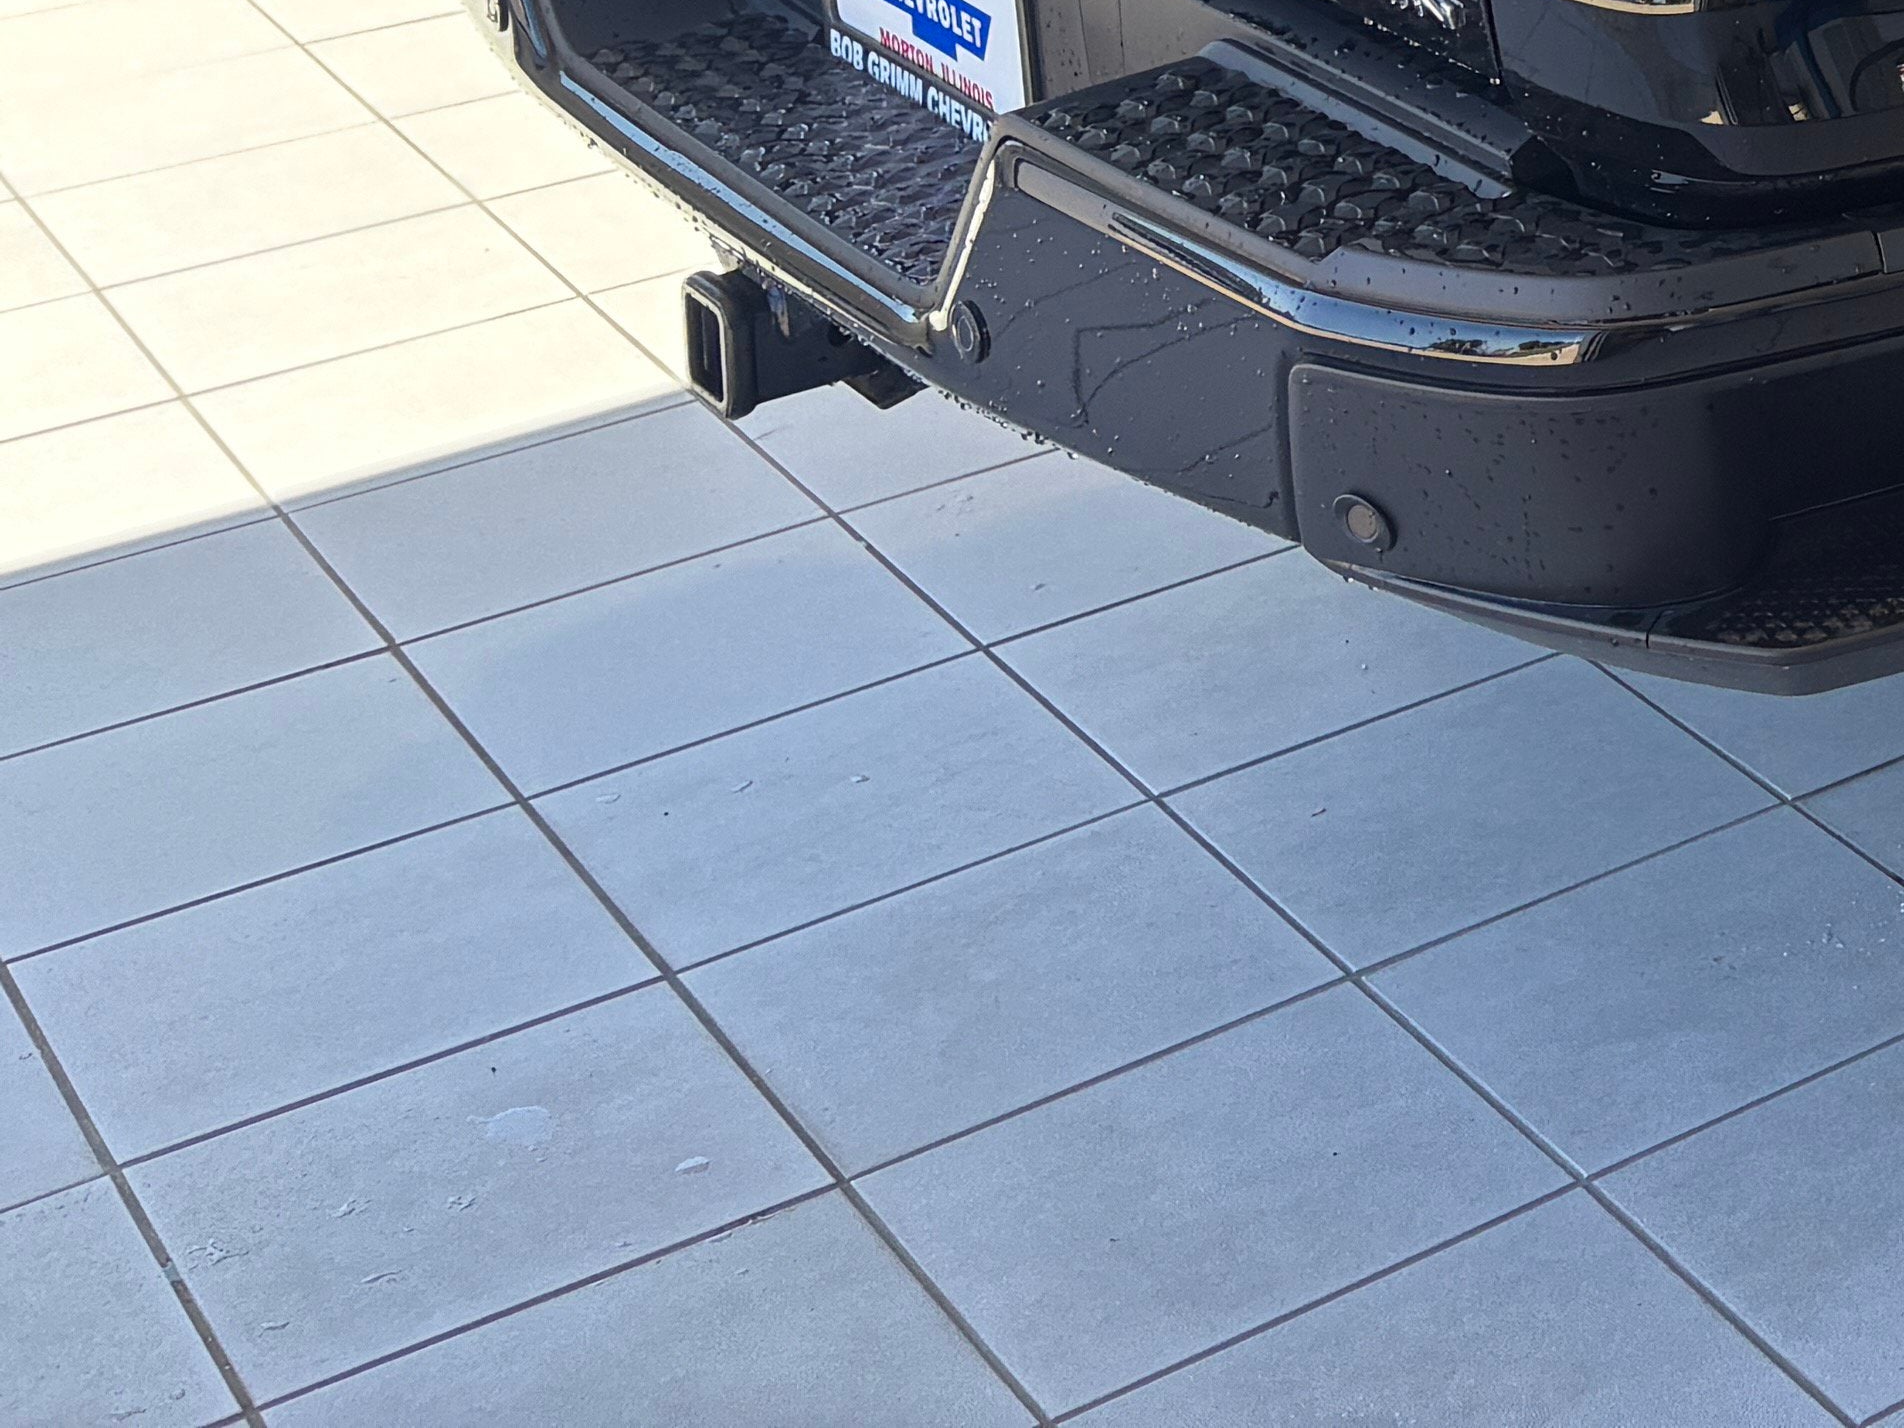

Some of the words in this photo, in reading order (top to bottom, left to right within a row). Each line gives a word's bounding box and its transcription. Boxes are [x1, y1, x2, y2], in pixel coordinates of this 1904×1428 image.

[830, 28, 863, 71] BOB
[867, 55, 923, 105] GRIMM
[879, 27, 934, 75] MORTON
[940, 62, 994, 113] ILLINOIS
